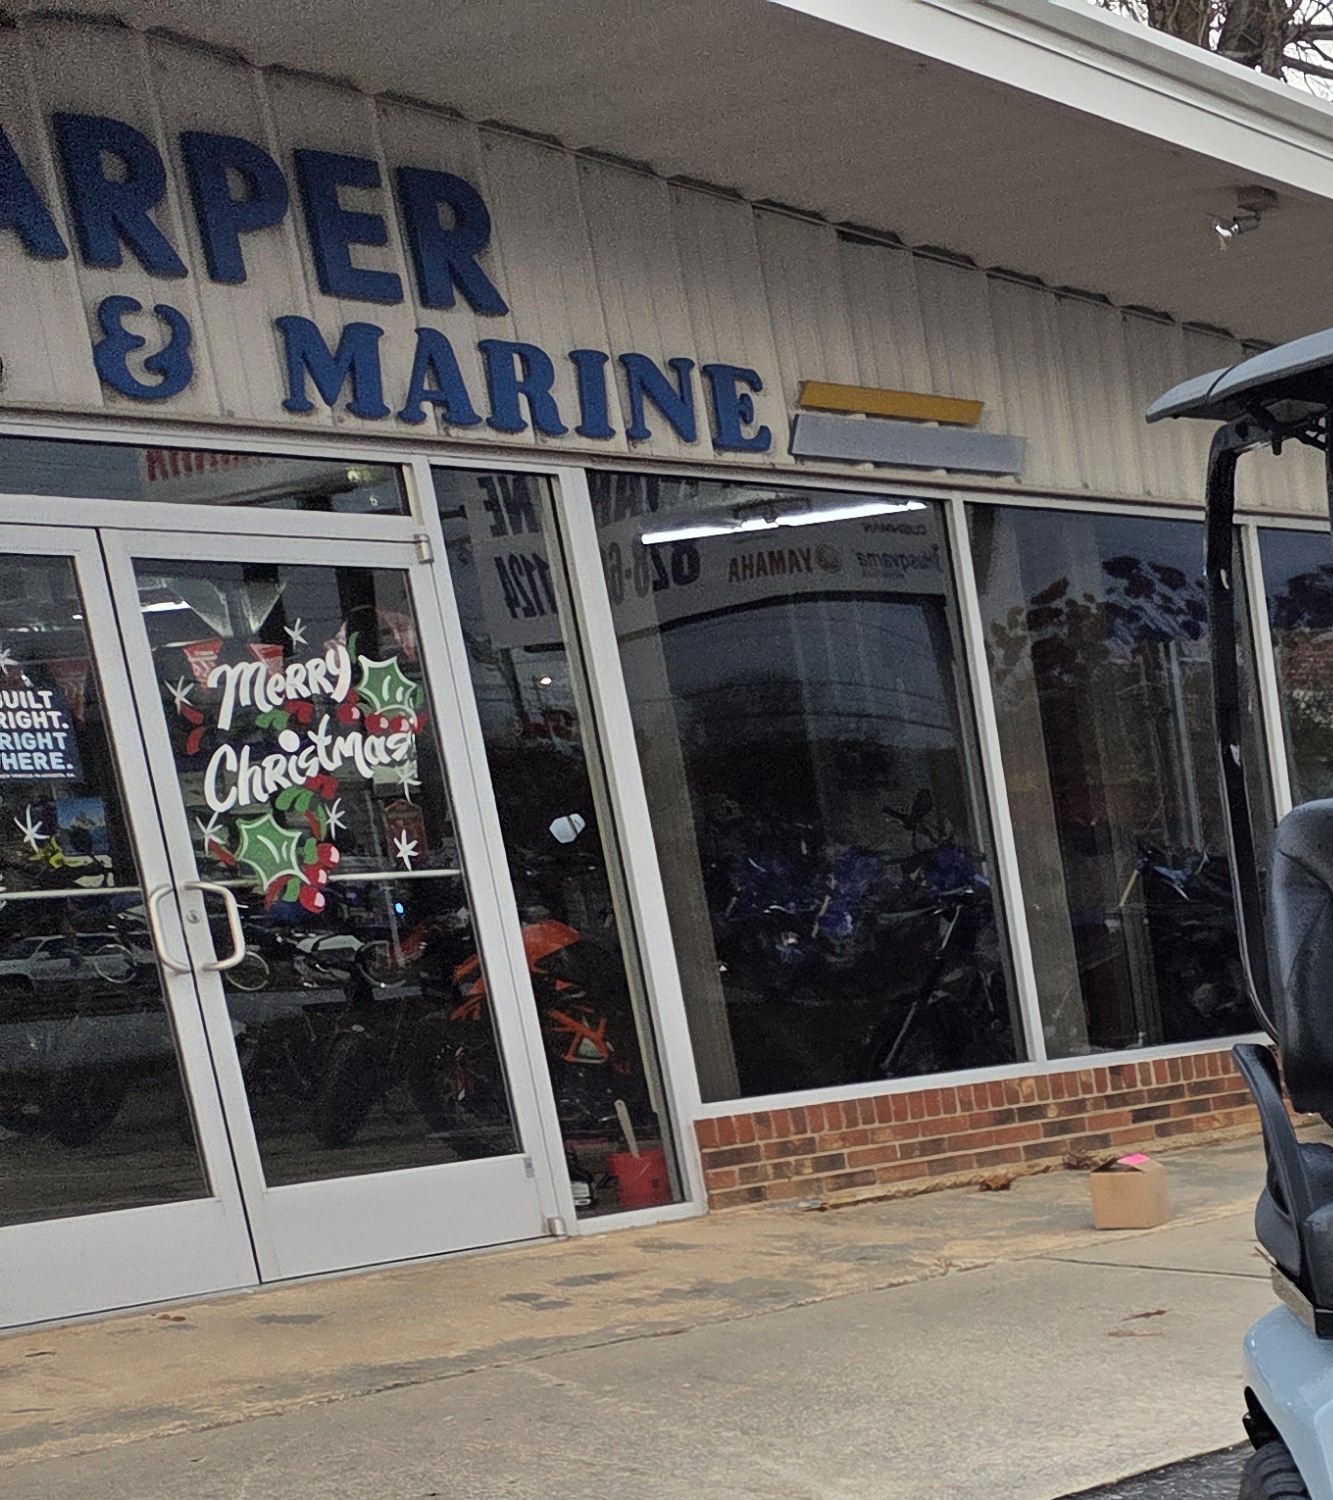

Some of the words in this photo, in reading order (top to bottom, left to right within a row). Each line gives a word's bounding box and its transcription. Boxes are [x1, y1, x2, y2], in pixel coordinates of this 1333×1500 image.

[93, 294, 193, 401] &
[275, 315, 773, 453] MARINE
[0, 690, 53, 709] UILT
[0, 710, 70, 729] RIGHT.
[0, 731, 68, 750] RIGHT
[1, 751, 74, 771] HERE.
